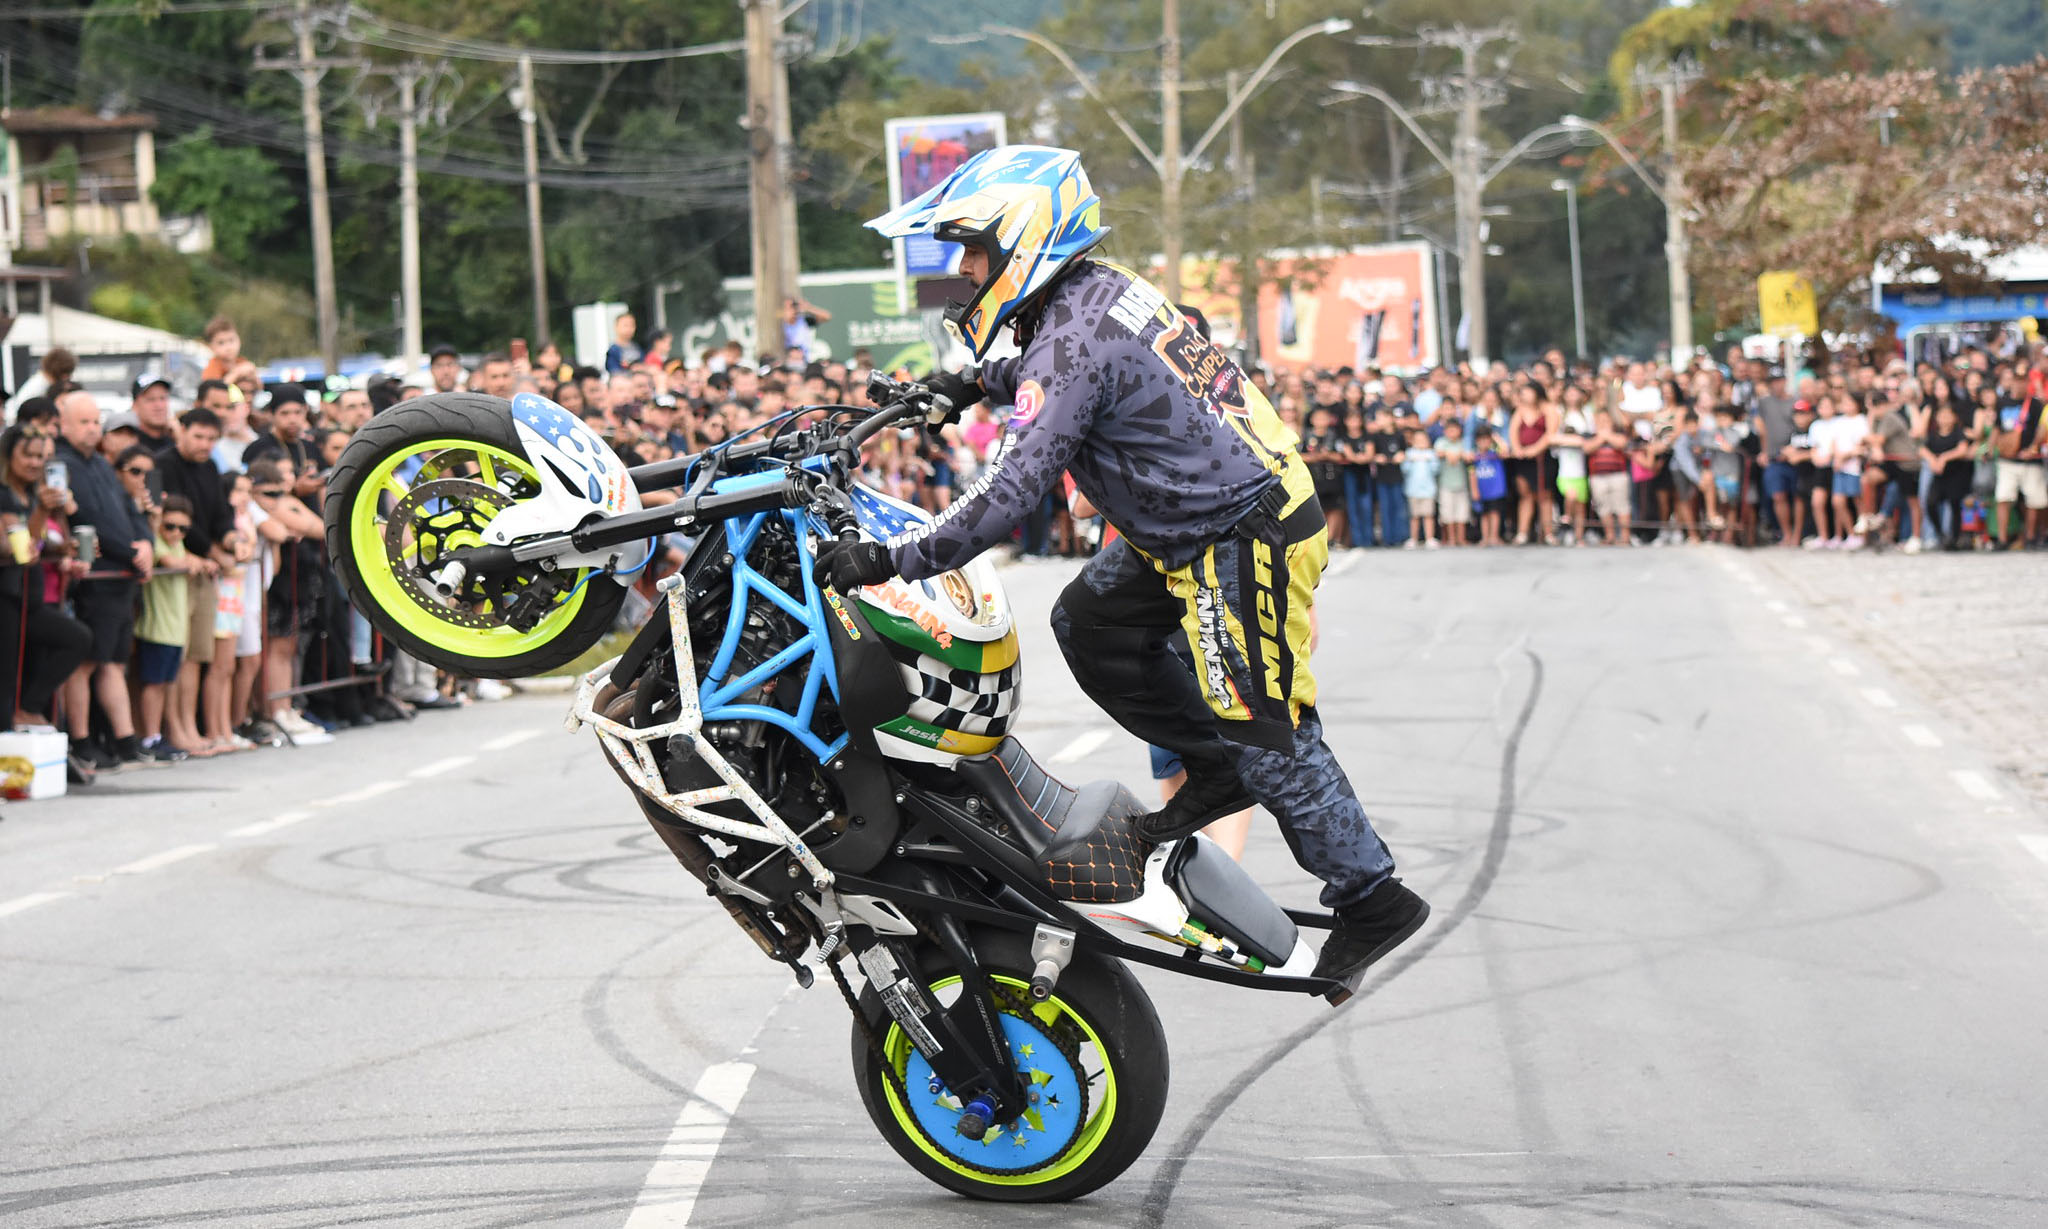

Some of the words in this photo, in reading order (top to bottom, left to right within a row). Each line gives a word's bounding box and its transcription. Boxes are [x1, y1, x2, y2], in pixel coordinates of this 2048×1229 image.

[1215, 587, 1226, 617] show
[1216, 618, 1229, 648] moto
[1252, 537, 1285, 701] MCR
